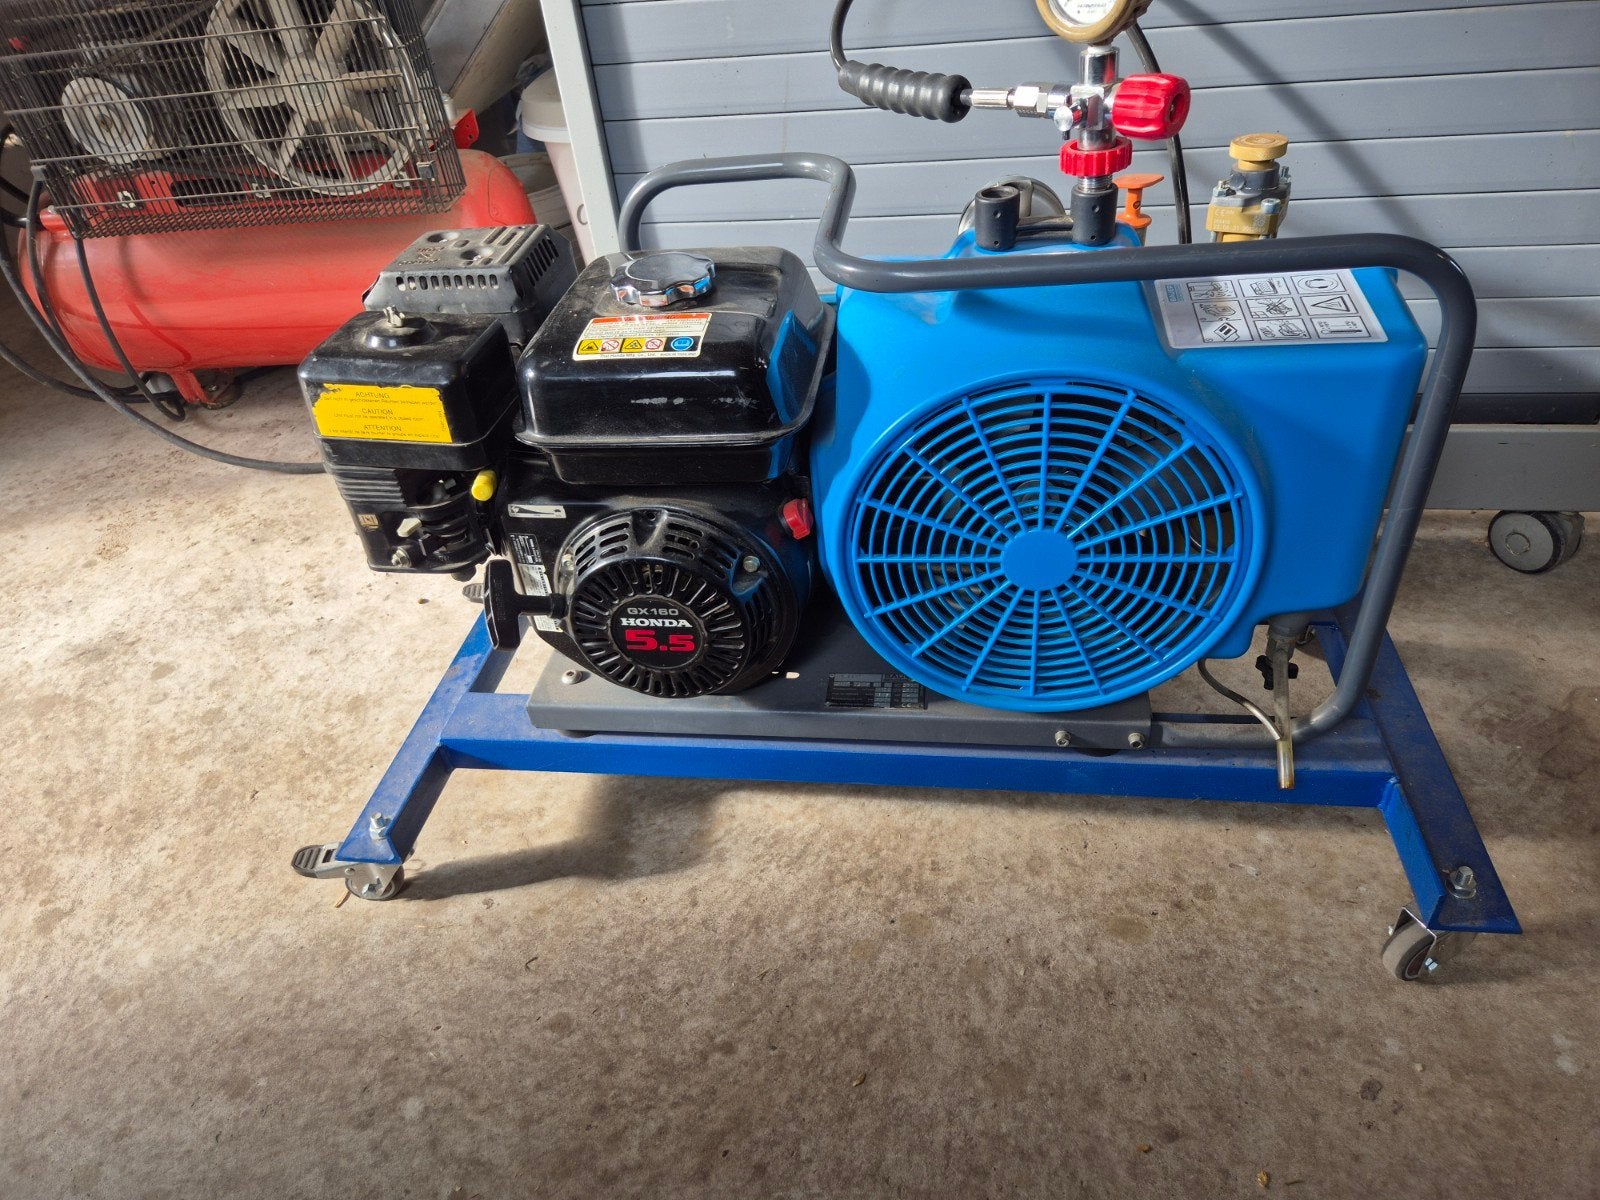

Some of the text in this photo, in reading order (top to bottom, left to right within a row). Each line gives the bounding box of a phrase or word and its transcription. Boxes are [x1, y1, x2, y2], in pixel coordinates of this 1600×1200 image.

[355, 391, 390, 399] ACHTUNG
[363, 424, 402, 432] ATTENTION
[627, 607, 680, 616] GX160
[620, 617, 693, 628] HONDA
[625, 629, 695, 652] 5.5
